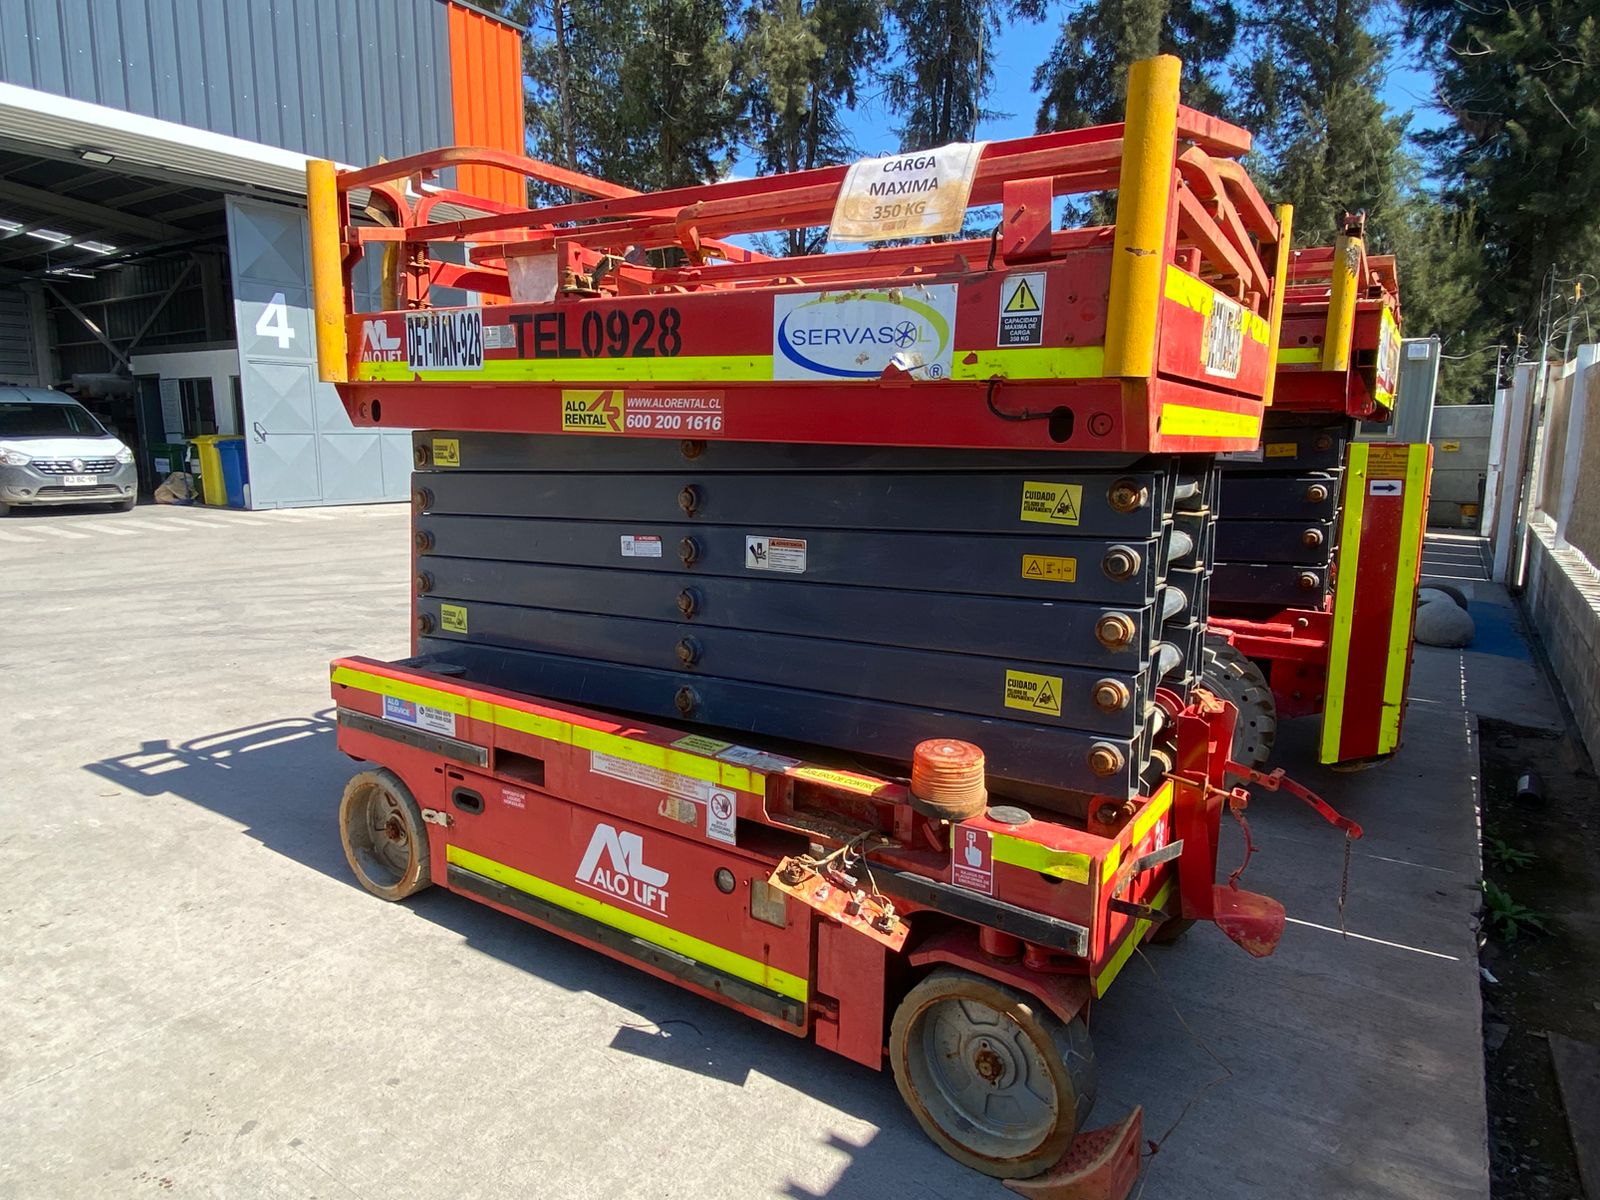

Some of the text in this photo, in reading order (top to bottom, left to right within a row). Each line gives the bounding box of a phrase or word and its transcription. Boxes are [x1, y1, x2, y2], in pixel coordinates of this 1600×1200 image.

[883, 156, 936, 173] CARGA
[869, 177, 938, 196] MAXIMA
[872, 201, 926, 219] 350 KG
[255, 292, 295, 349] 4
[407, 312, 482, 367] DET-MAN-928
[509, 307, 682, 358] TEL0928
[791, 321, 932, 348] SERVASOL
[363, 351, 382, 362] ALO
[565, 401, 586, 412] ALO
[627, 398, 721, 409] WWW.ALORENTAL.CL
[565, 413, 606, 425] RENTAL
[626, 415, 722, 431] 600 200 1616
[1024, 490, 1056, 501] CUIDADO
[1007, 679, 1037, 691] CUIDADO
[593, 867, 669, 912] ALO LIFT
